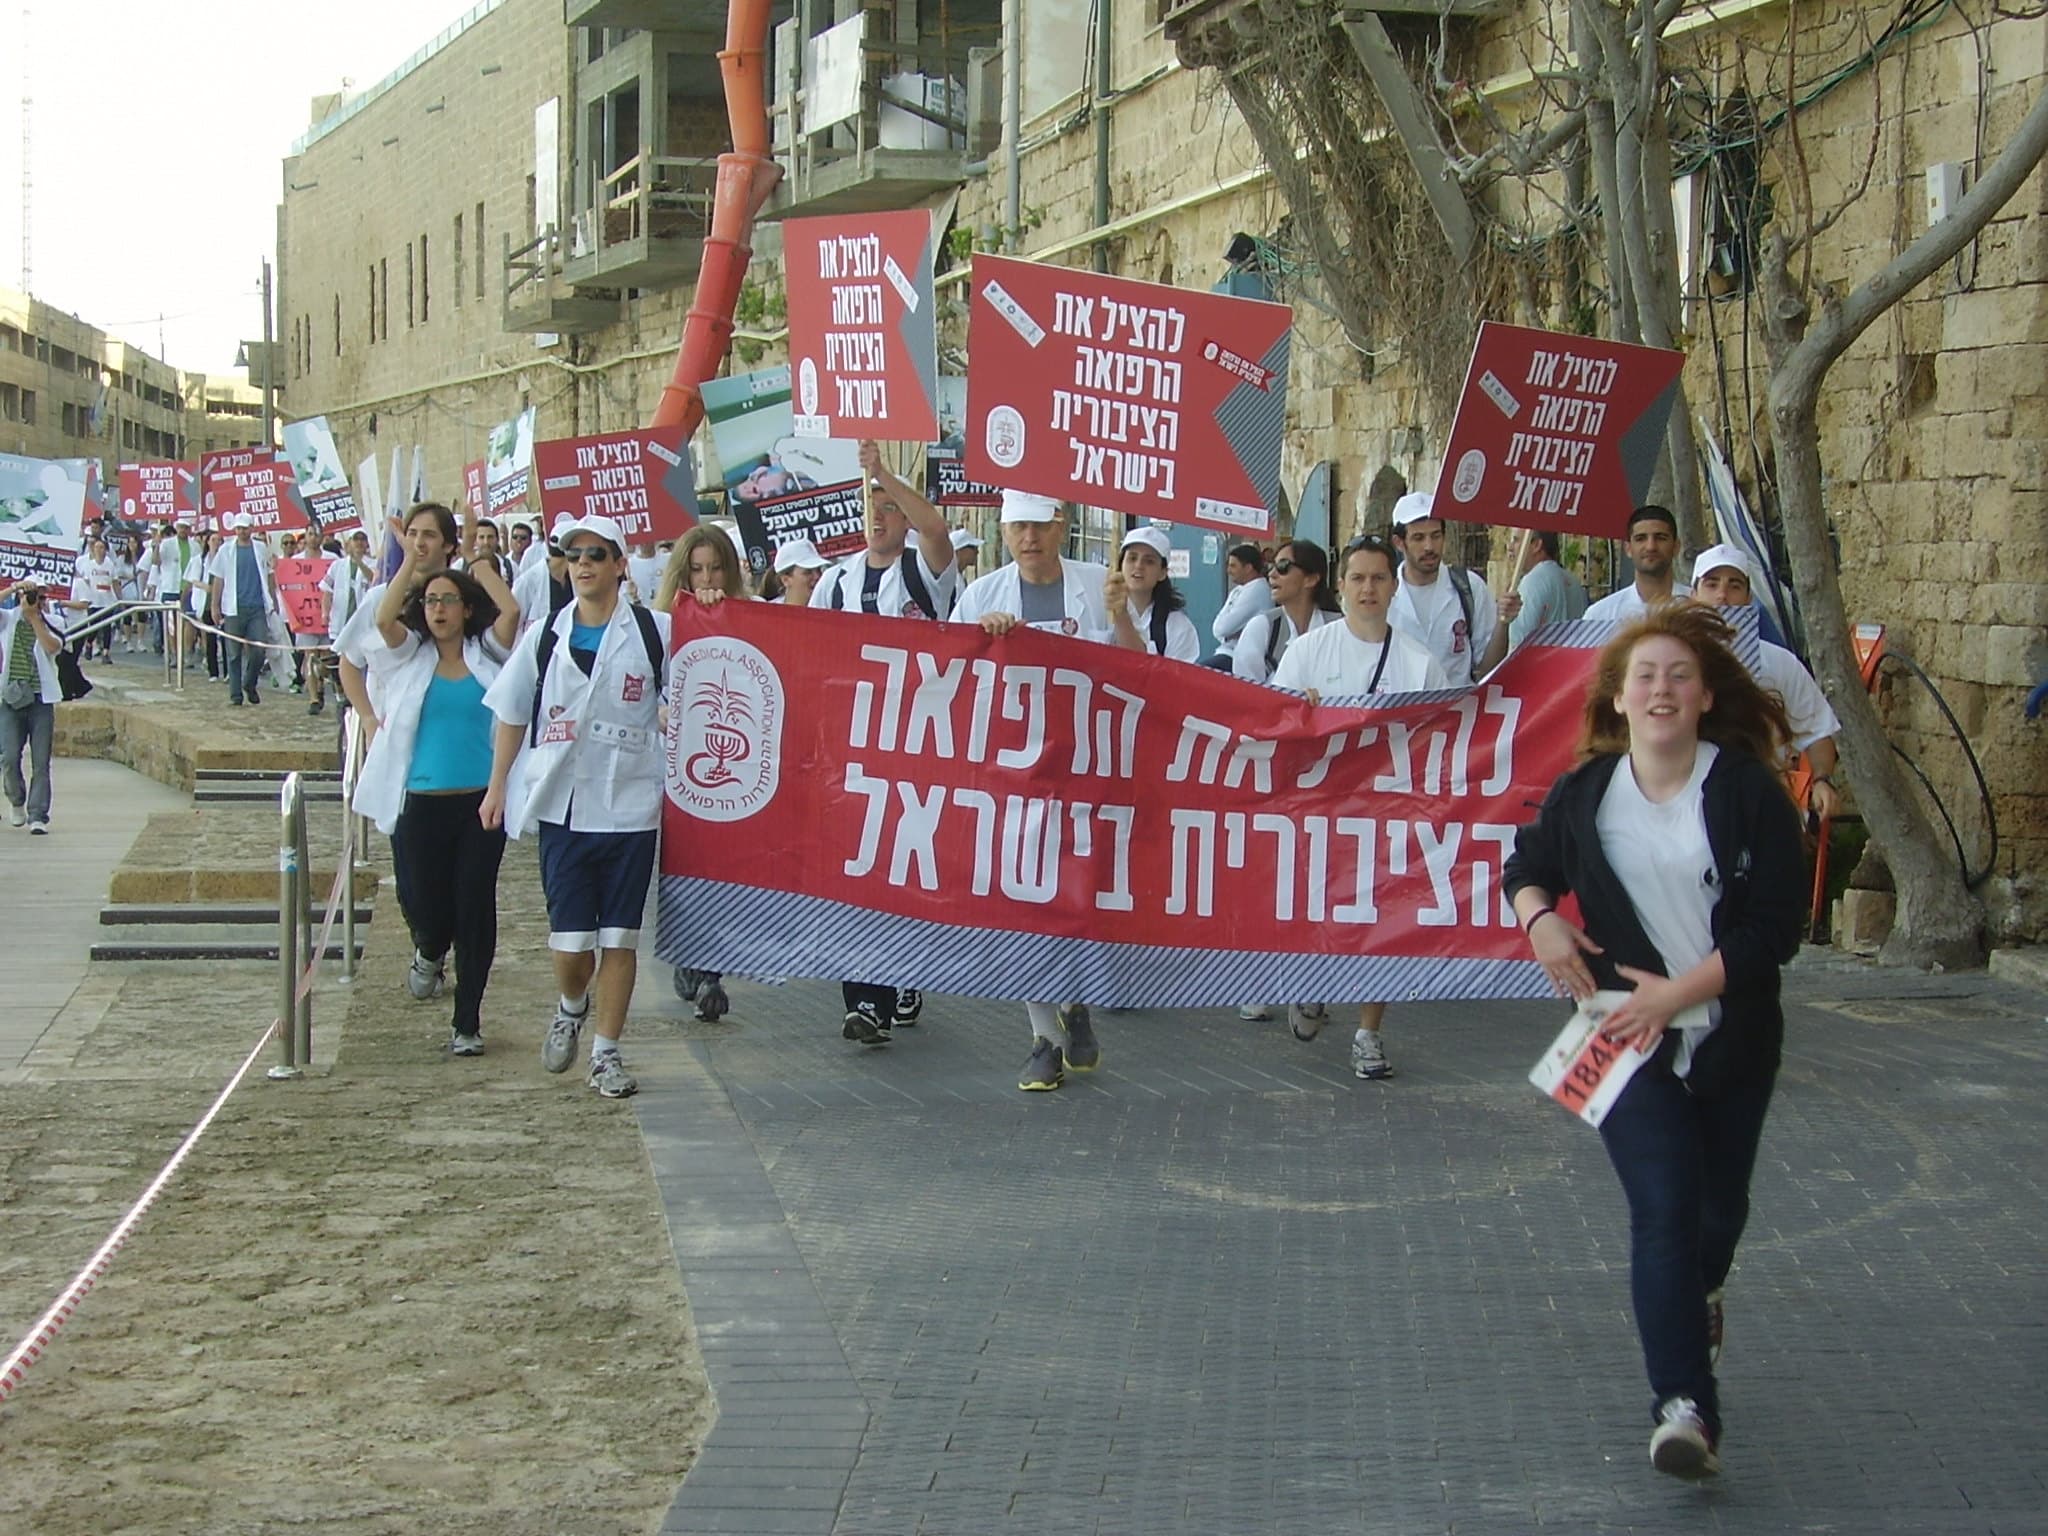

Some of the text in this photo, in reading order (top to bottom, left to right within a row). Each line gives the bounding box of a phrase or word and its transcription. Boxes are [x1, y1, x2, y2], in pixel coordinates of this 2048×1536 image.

[818, 233, 879, 279] להציל את
[831, 285, 883, 325] הרפואה
[1053, 292, 1185, 353] להציל את
[825, 332, 885, 371] הציבורית
[1075, 345, 1182, 403] הרפואה
[1525, 350, 1618, 396] להציל את
[835, 375, 888, 419] בישראל
[1530, 393, 1607, 436] הרפואה
[1051, 389, 1179, 451] הציבורית
[576, 439, 640, 469] להציל את
[1069, 437, 1175, 499] בישראל
[1504, 433, 1595, 476] הציבורית
[591, 464, 645, 490] הרפואה
[938, 479, 967, 496] שלך
[1508, 472, 1584, 516] בישראל
[253, 512, 280, 526] בישרא
[584, 488, 648, 515] הציבורית
[762, 507, 819, 531] שיטפל
[823, 502, 844, 517] מי
[614, 512, 652, 535] בישר
[813, 515, 864, 544] תינוק
[0, 552, 37, 567] שיטפ
[0, 562, 26, 579] של
[40, 558, 55, 570] מי
[56, 560, 74, 573] אין
[671, 668, 687, 720] ISRAELI
[682, 647, 734, 669] MEDICAL
[737, 653, 774, 738] ASSOCIATION
[849, 643, 1146, 780] הרפואה
[1166, 714, 1278, 794] את
[673, 781, 735, 811] הרפואית
[843, 761, 1518, 928] הציבורית בישראל
